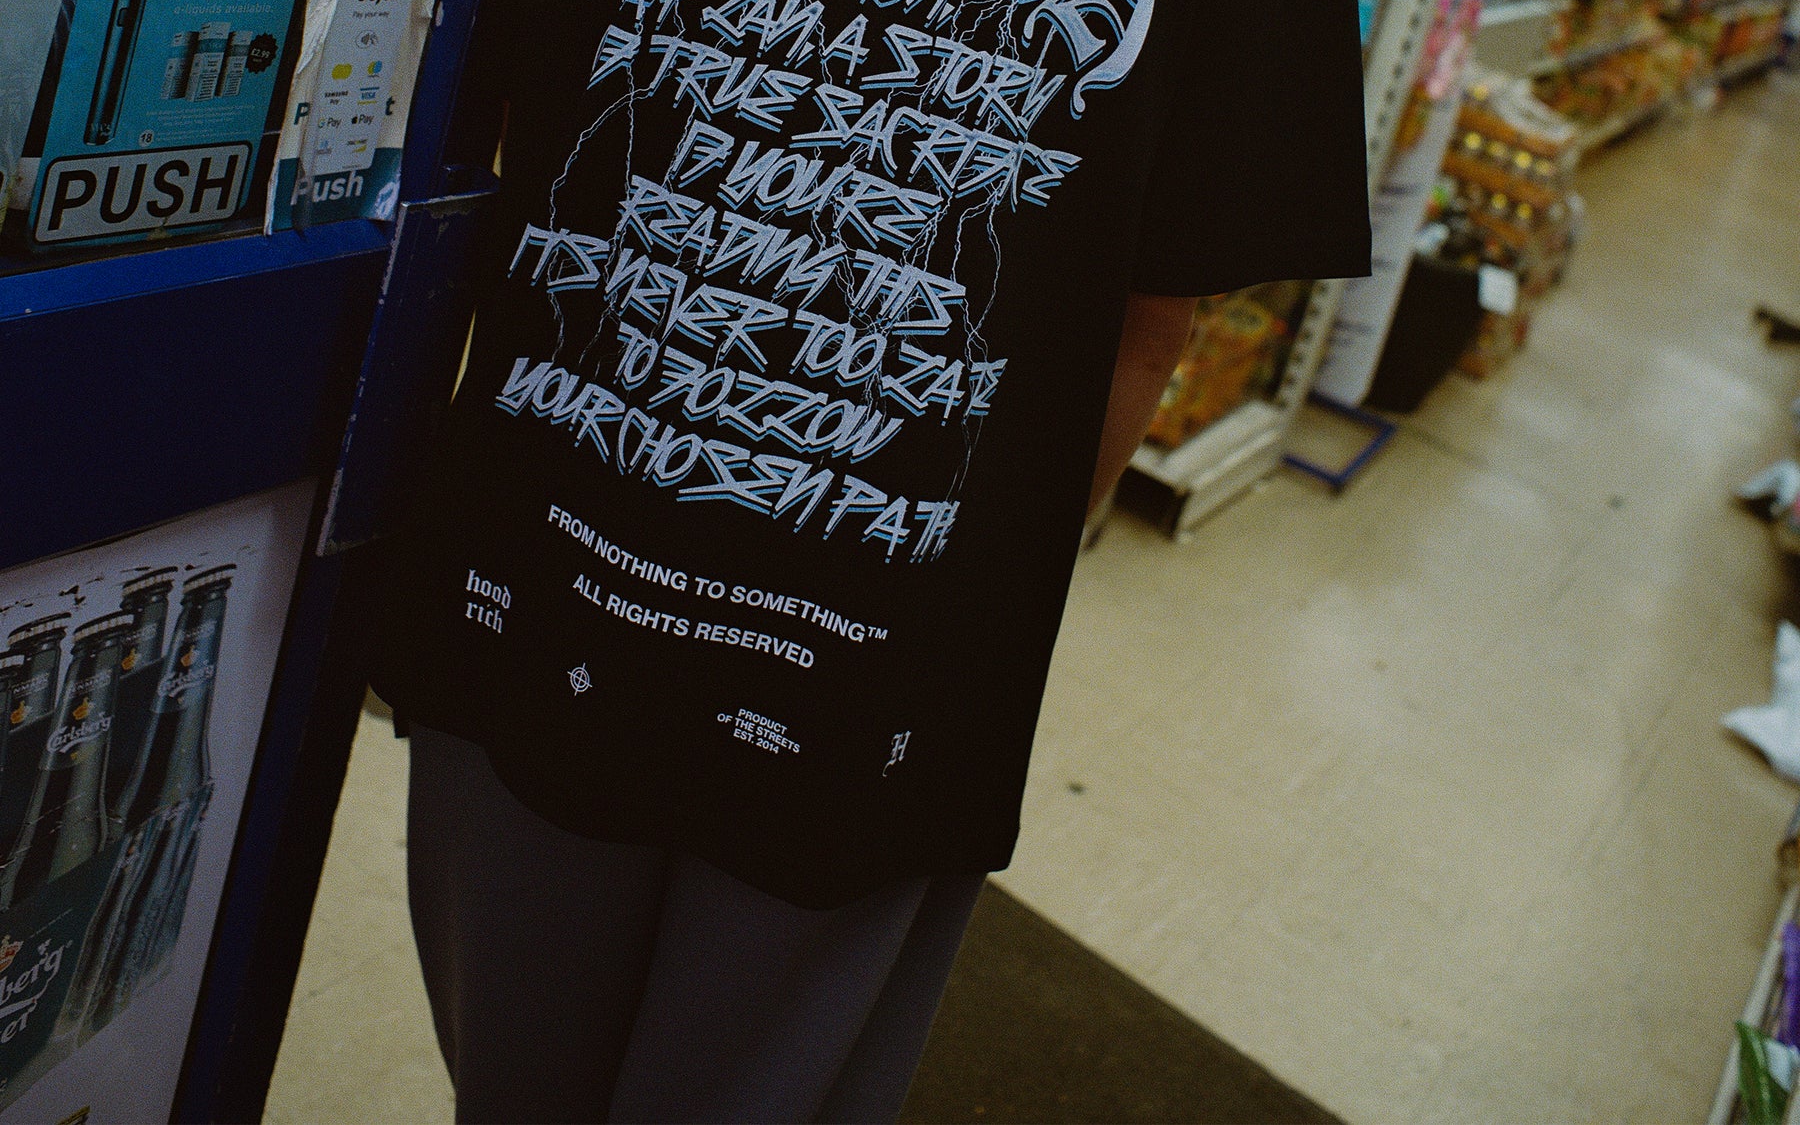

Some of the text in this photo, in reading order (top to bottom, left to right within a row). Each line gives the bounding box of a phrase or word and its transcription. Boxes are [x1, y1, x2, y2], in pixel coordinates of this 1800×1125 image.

[821, 14, 870, 85] A
[649, 34, 813, 132] TRUE
[359, 114, 374, 125] Pay
[48, 155, 238, 231] PUSH
[291, 172, 363, 206] Push
[547, 504, 596, 548] FROM
[594, 536, 688, 592] NOTHING
[695, 577, 726, 600] TO
[465, 569, 512, 609] hood
[465, 602, 502, 634] rich
[572, 574, 815, 669] ALL RIGHTS RESERVED
[46, 711, 114, 753] Carlsberg
[717, 713, 801, 754] OF THE STREETS
[733, 728, 780, 754] EST. 2014
[737, 708, 788, 735] PRODUCT
